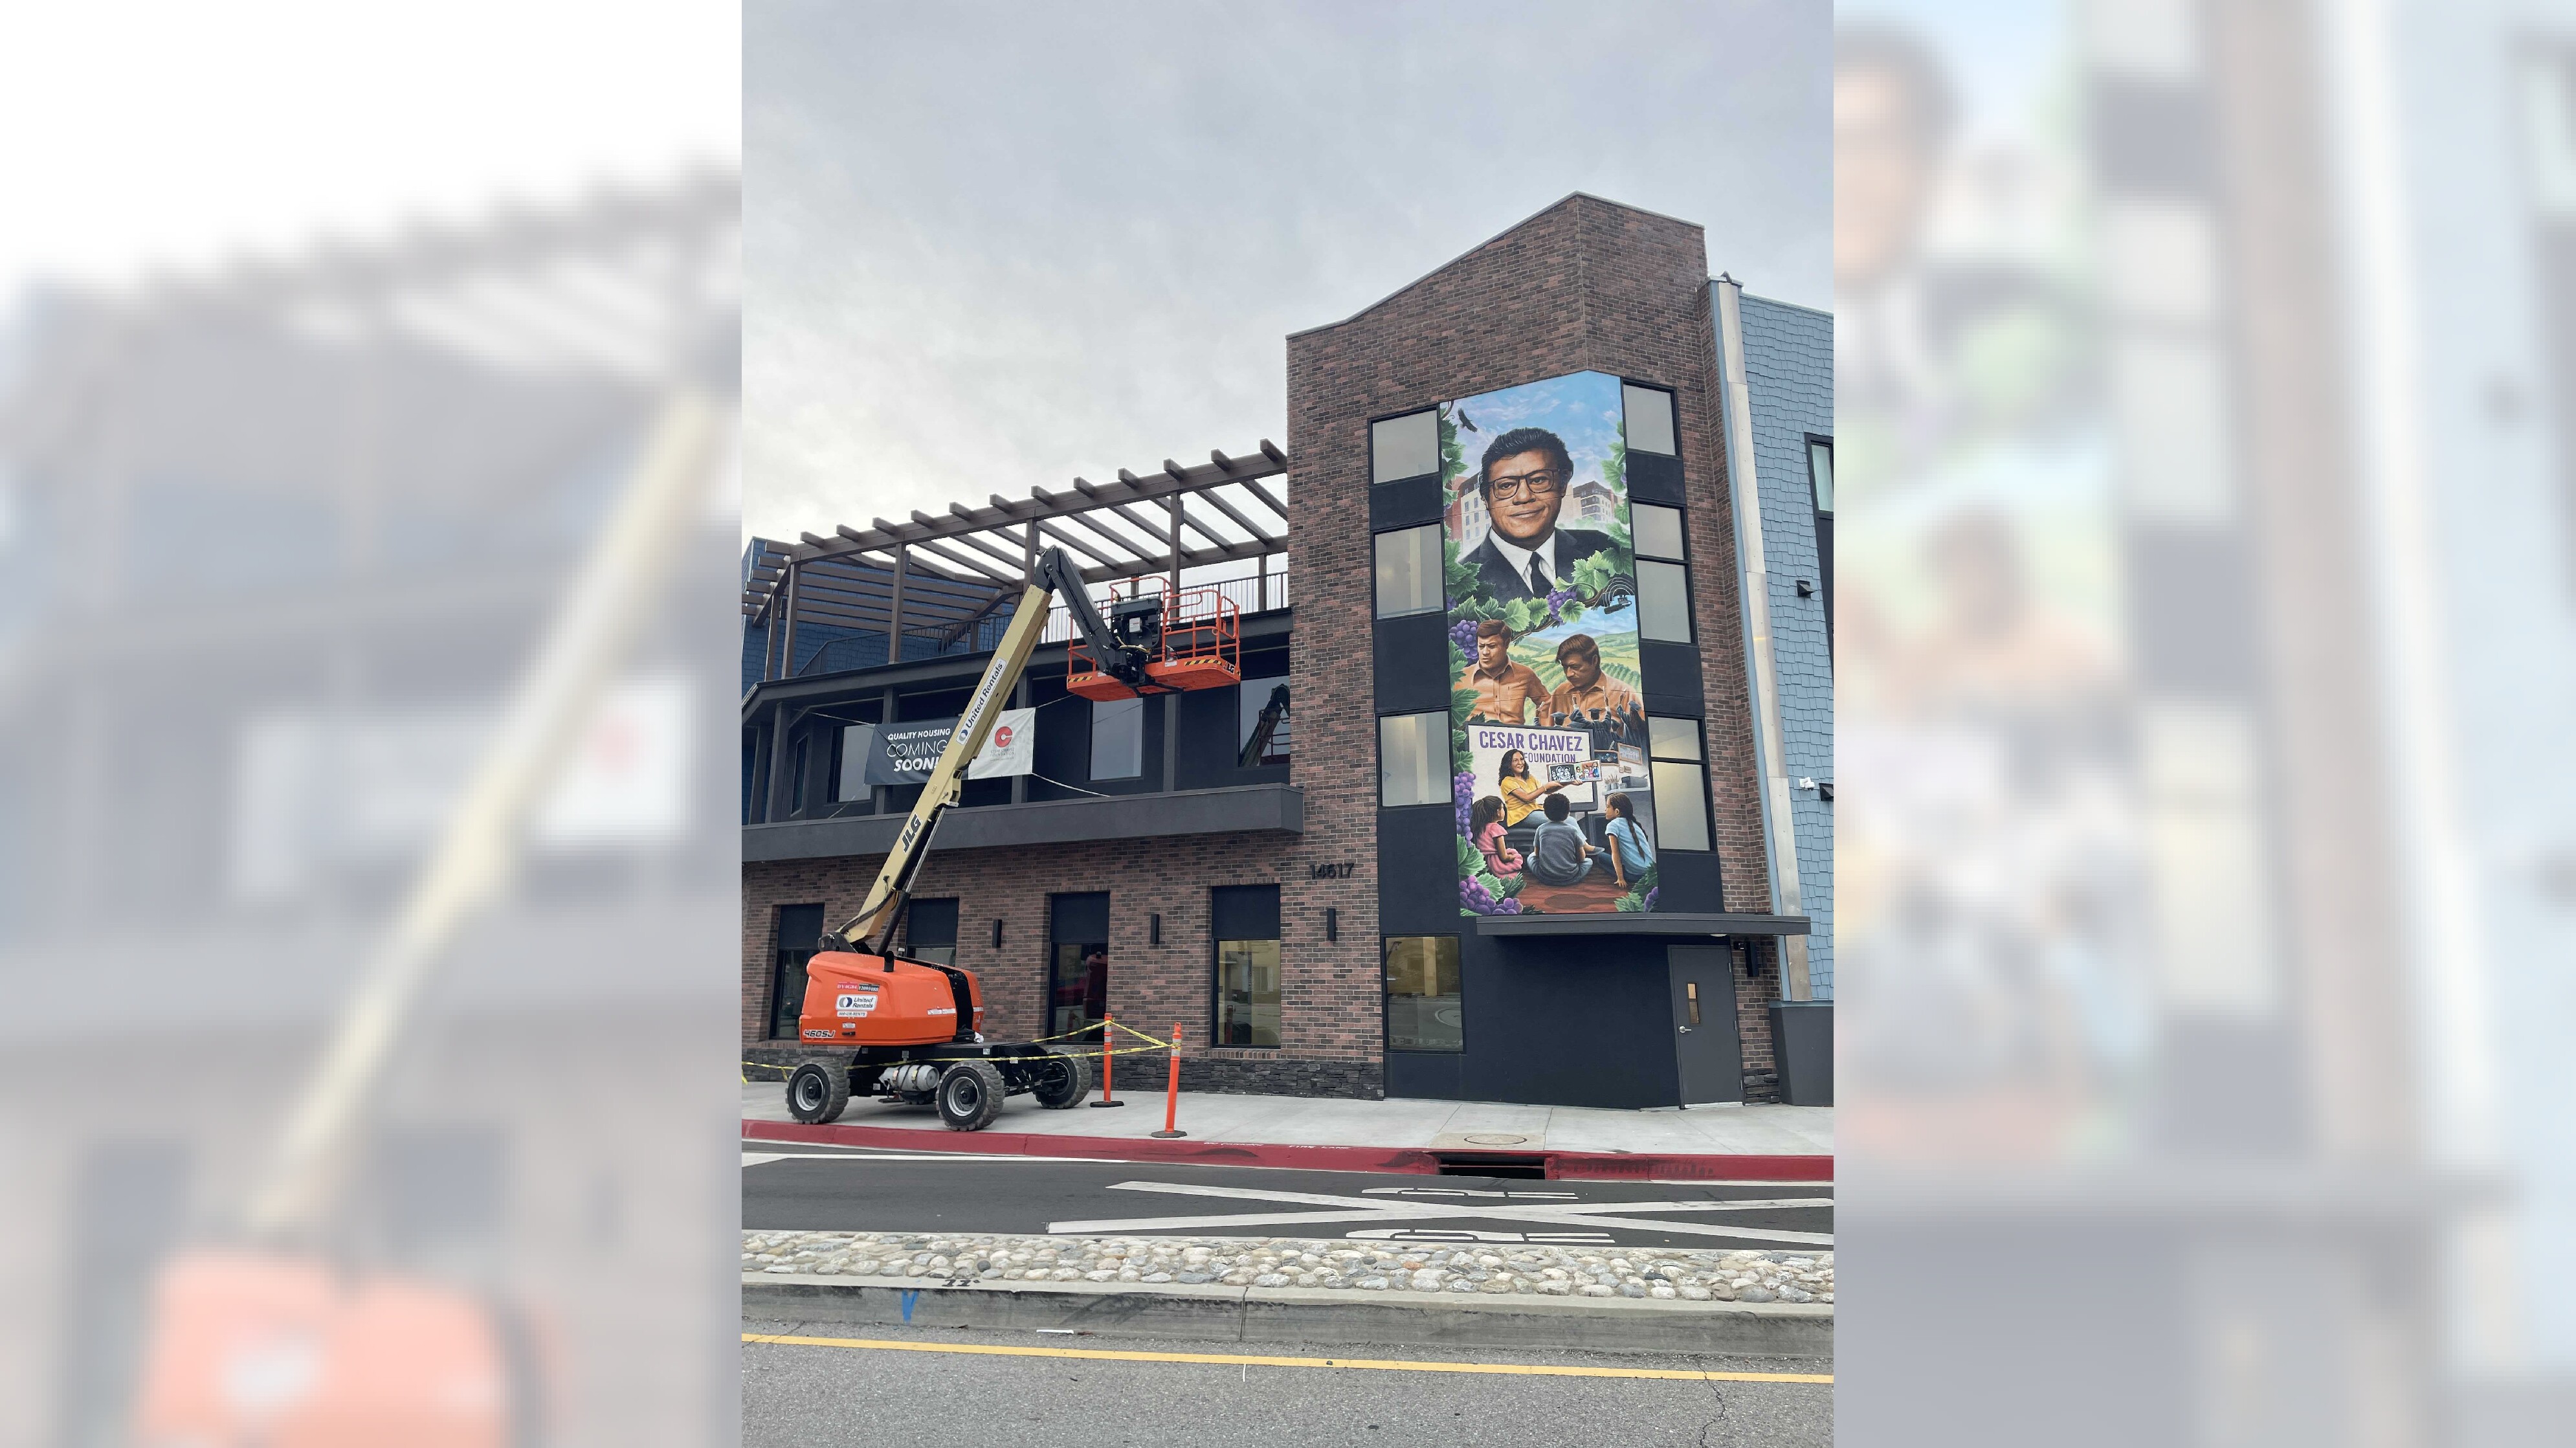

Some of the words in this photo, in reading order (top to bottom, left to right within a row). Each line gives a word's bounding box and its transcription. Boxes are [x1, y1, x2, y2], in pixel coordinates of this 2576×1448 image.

[966, 696, 985, 728] United
[983, 663, 1003, 697] Rentals
[887, 731, 917, 741] QUALITY
[917, 728, 951, 738] HOUSING
[1479, 731, 1525, 749] CESAR
[1528, 733, 1583, 752] CHAVEZ
[887, 740, 948, 757] COMING
[902, 813, 922, 854] JLG
[1309, 863, 1354, 880] 14617
